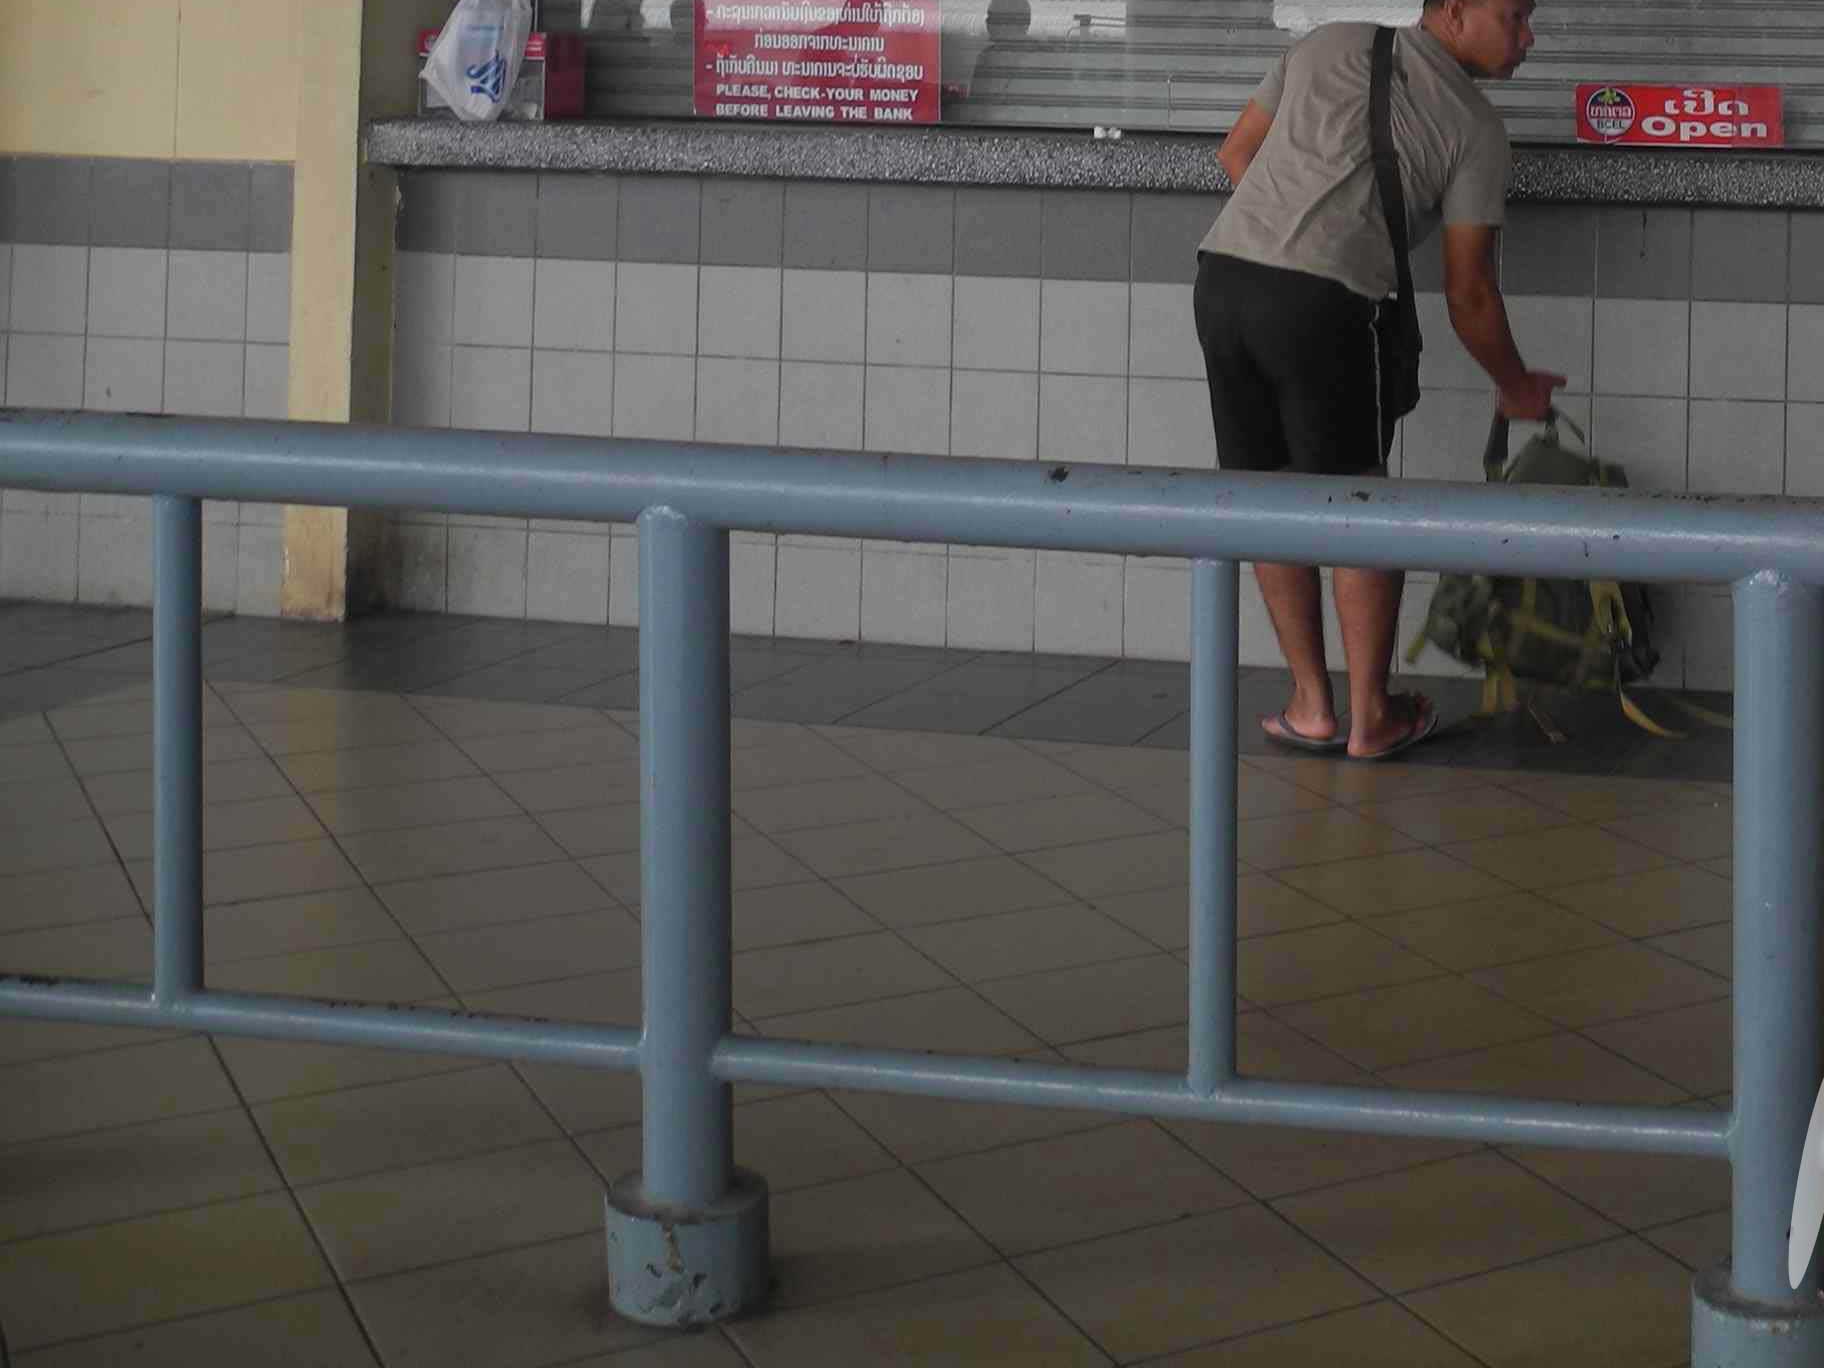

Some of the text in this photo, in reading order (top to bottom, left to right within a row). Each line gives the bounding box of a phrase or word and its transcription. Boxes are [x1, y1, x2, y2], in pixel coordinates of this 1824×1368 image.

[716, 84, 771, 100] PLEASE,
[870, 89, 918, 102] MONEY
[716, 104, 912, 120] BEFORE LEAVING THE BANK
[1641, 115, 1768, 141] Open
